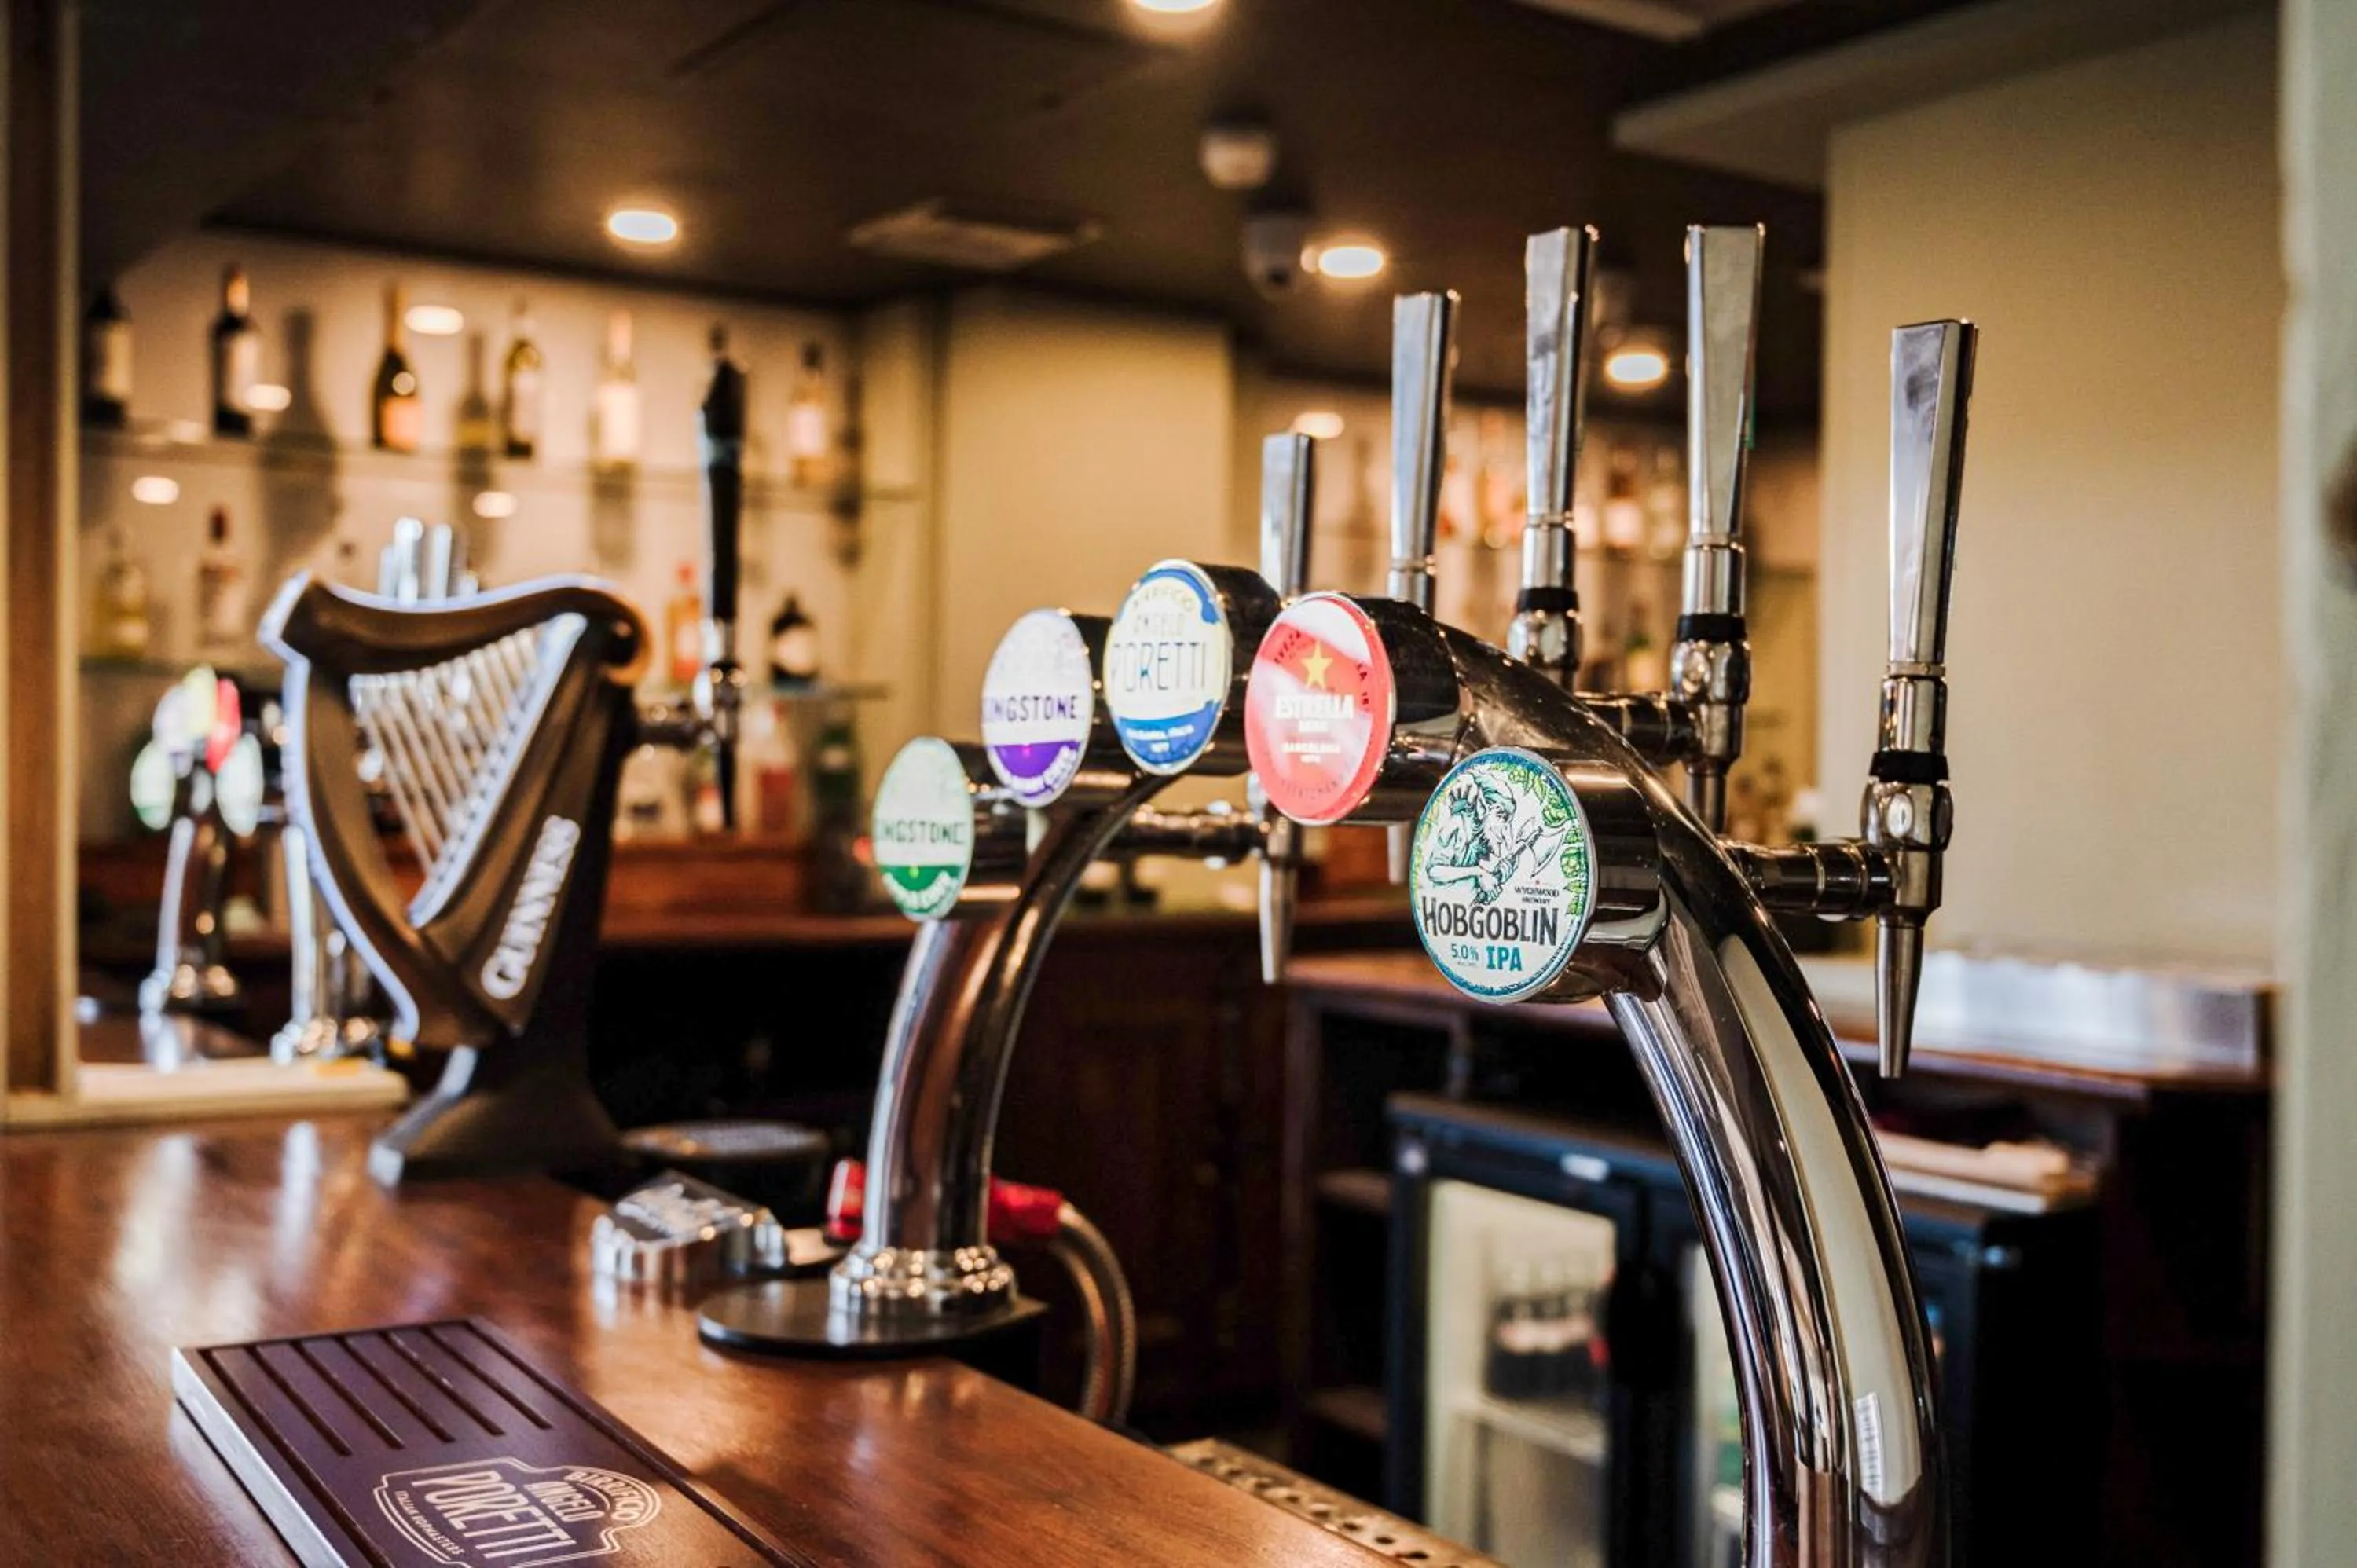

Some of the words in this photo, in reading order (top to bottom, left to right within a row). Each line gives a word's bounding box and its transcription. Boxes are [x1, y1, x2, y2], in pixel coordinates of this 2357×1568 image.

[1422, 896, 1560, 947] HOBGOBLIN
[1486, 945, 1523, 972] IPA
[411, 1470, 577, 1559] PORETTI
[522, 1481, 606, 1522] ANGELO
